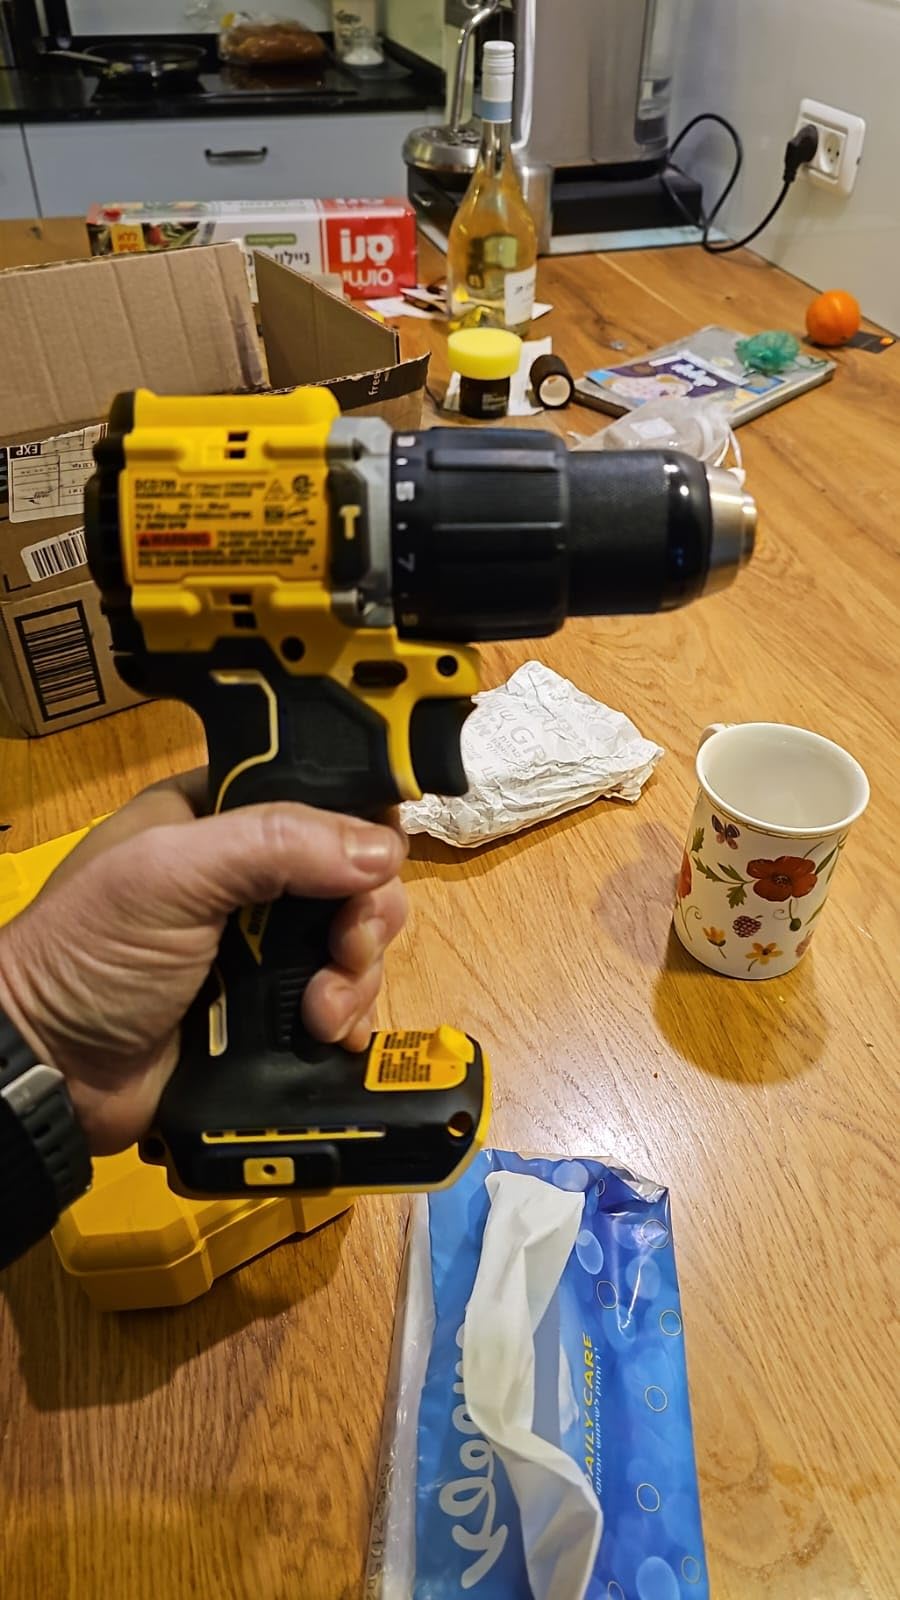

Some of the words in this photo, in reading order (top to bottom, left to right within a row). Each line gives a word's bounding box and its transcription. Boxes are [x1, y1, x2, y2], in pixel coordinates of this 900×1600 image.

[340, 228, 394, 266] סנו
[342, 267, 394, 290] סושי
[16, 444, 38, 456] EXP
[582, 1330, 594, 1408] CARE
[438, 1323, 509, 1590] Klee
